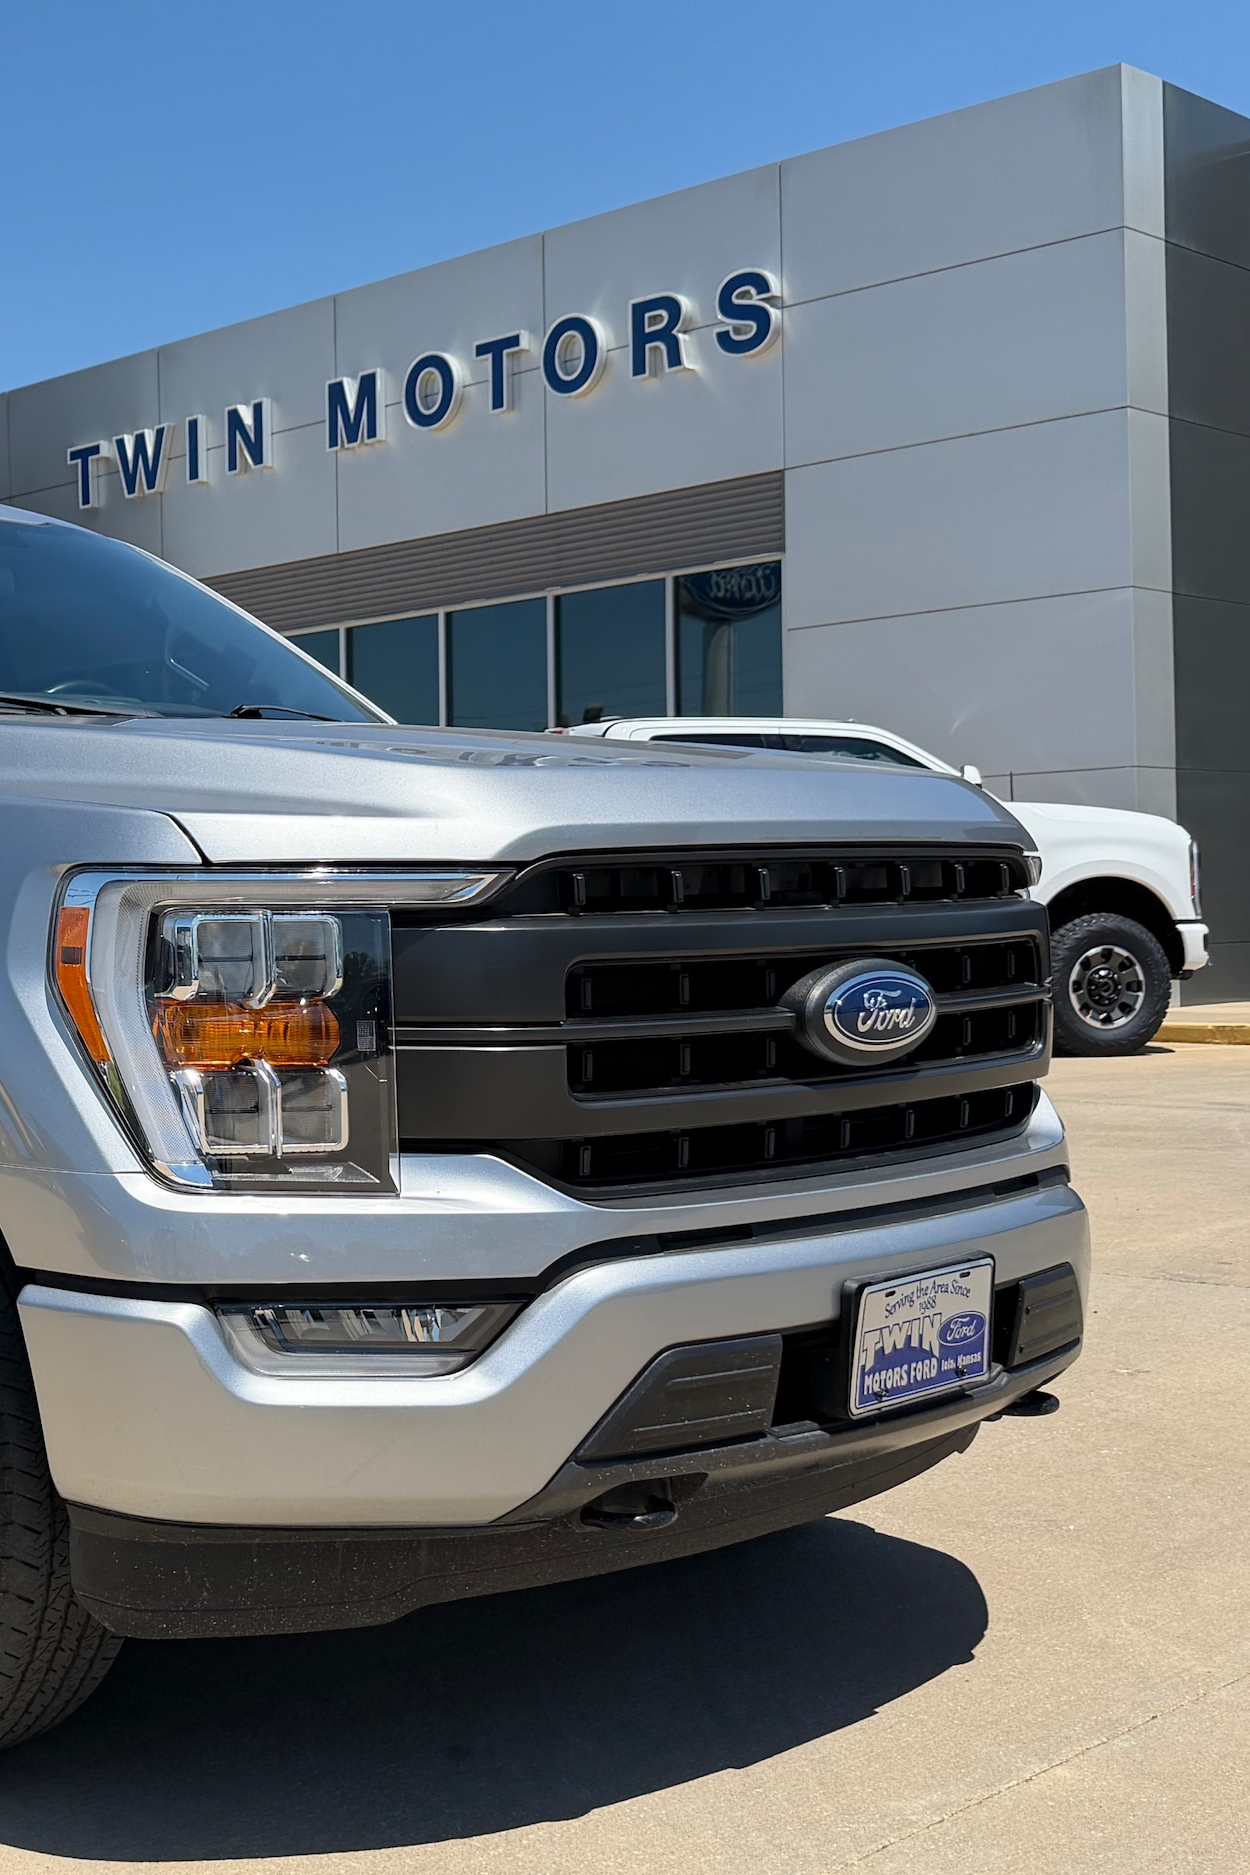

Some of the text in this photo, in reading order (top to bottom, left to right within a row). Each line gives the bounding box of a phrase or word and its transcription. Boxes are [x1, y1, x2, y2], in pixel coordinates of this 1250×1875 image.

[67, 268, 780, 509] TWIN MOTORS
[856, 988, 916, 1033] Ford
[885, 1278, 971, 1319] Serving the Area Since
[860, 1312, 943, 1371] TWIN
[946, 1316, 976, 1342] Ford
[863, 1357, 939, 1396] MOTORS FORD
[957, 1352, 982, 1368] Kansas
